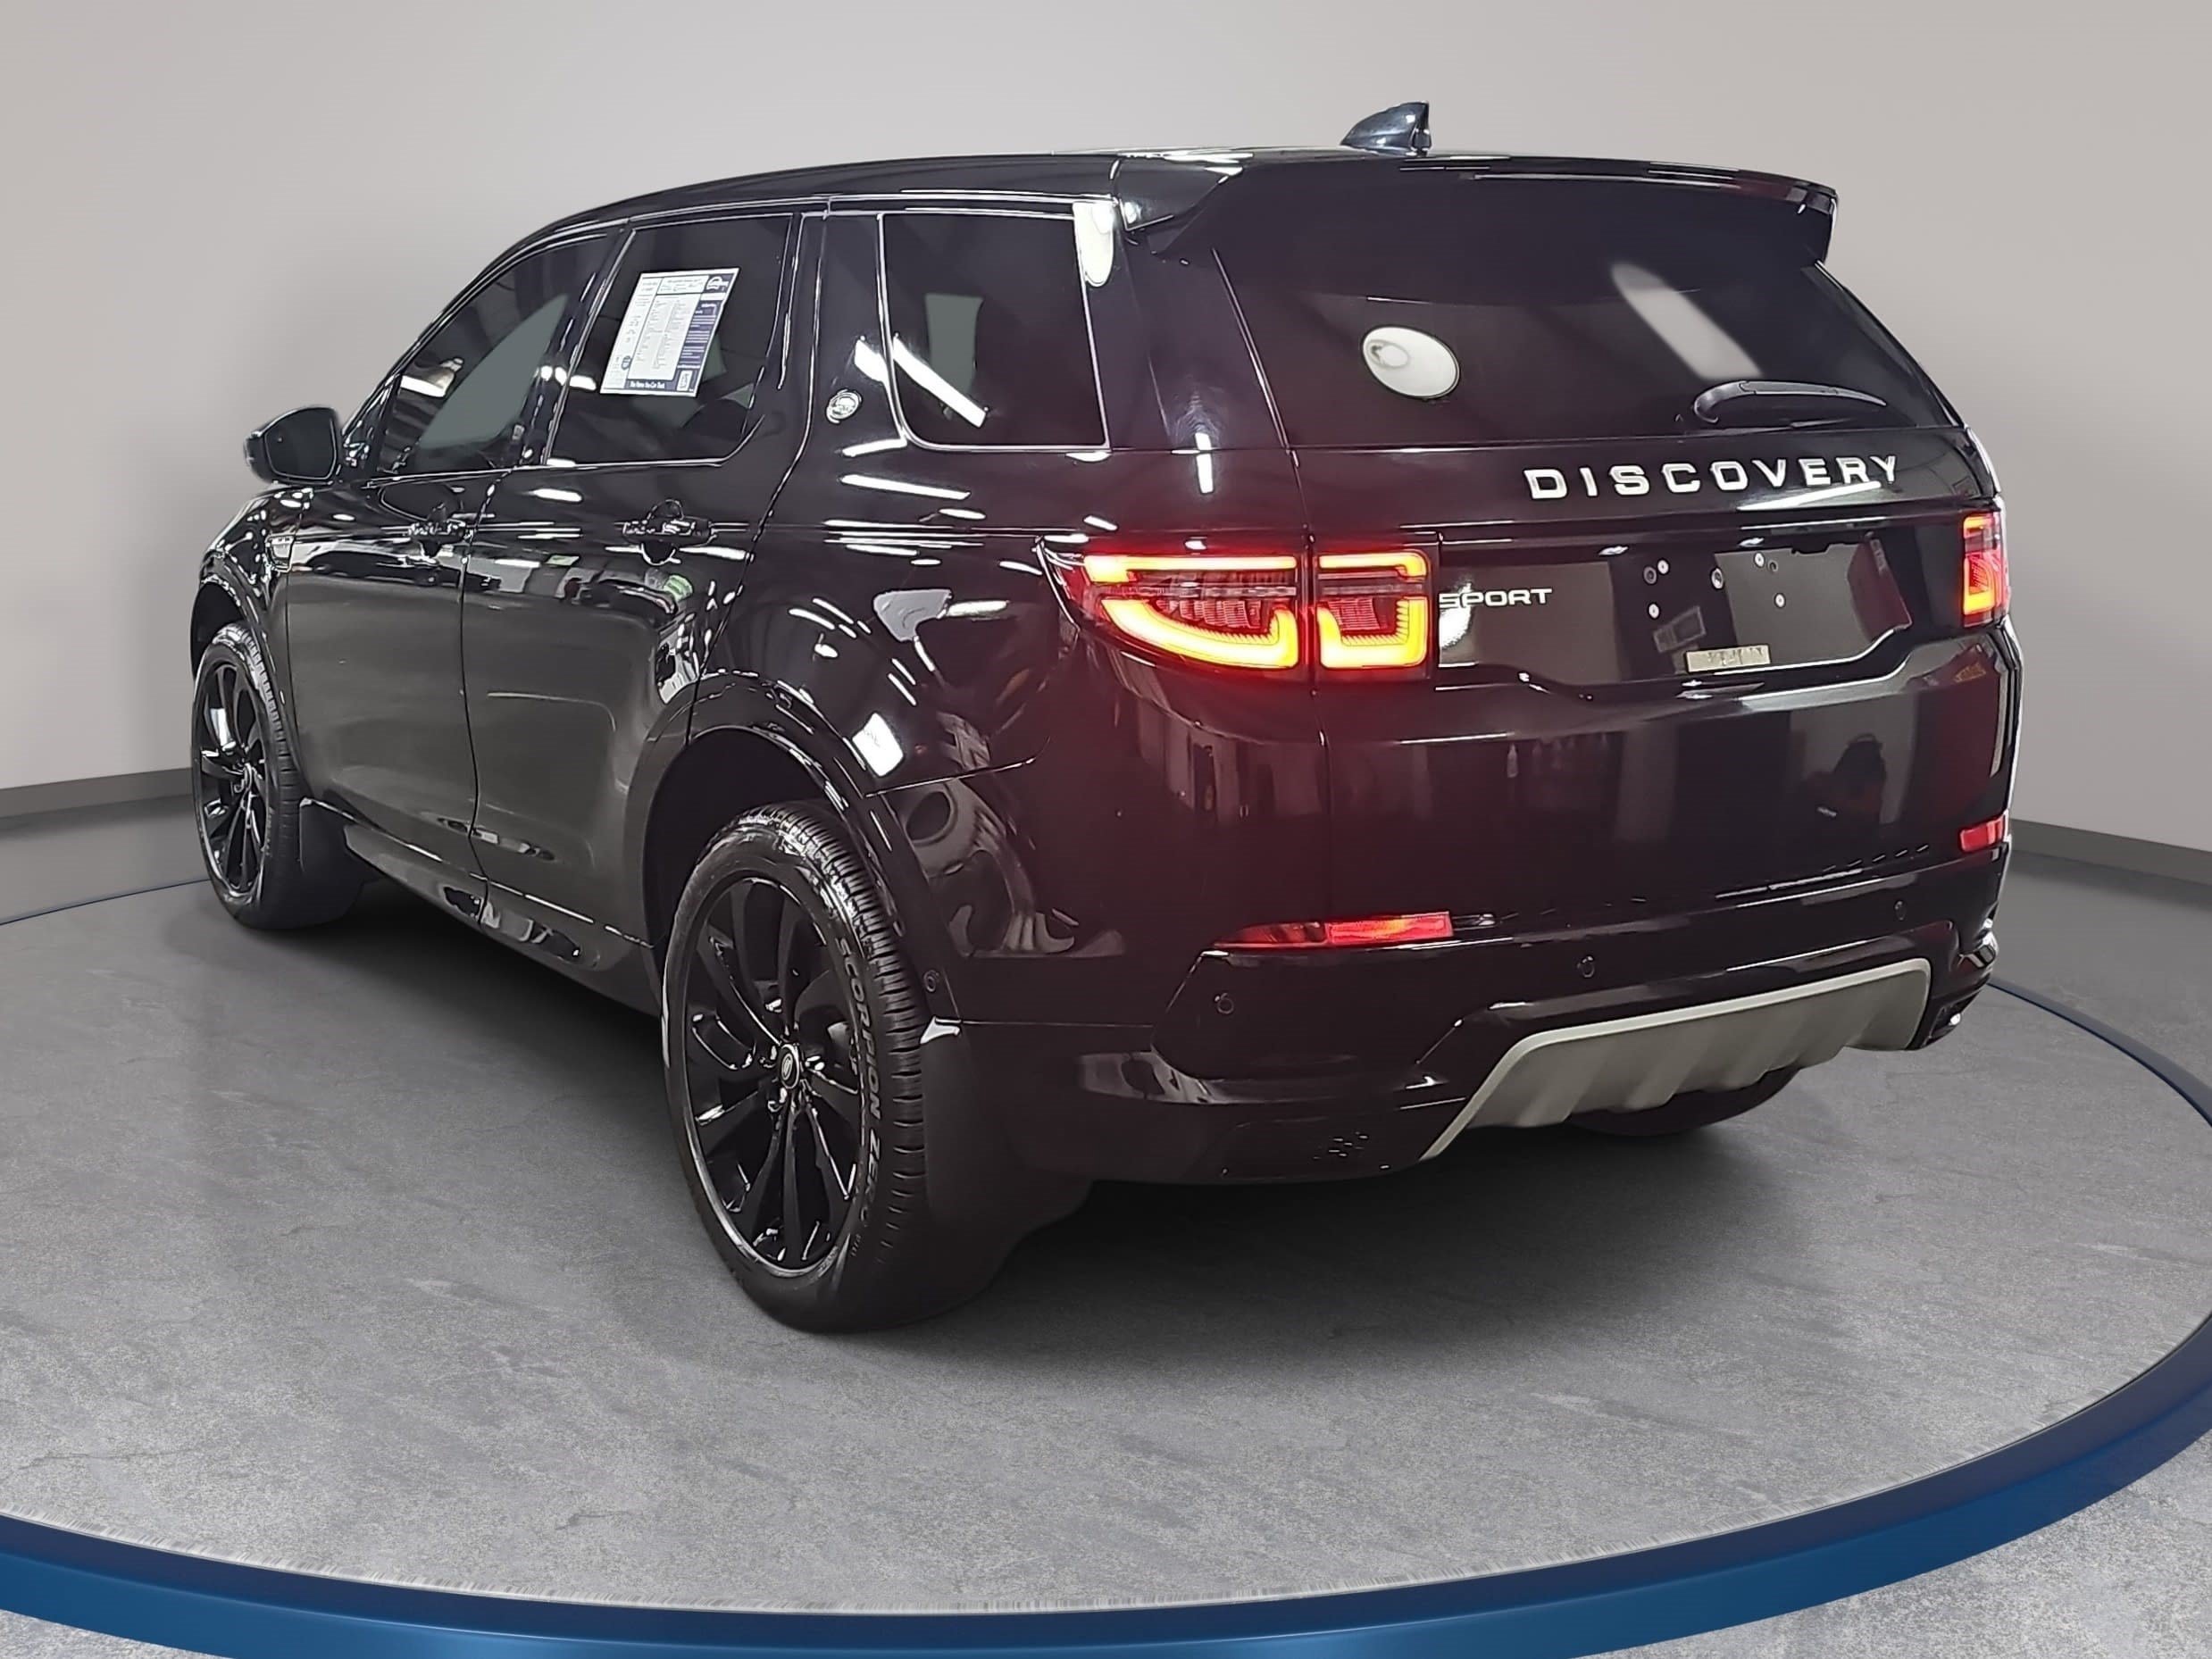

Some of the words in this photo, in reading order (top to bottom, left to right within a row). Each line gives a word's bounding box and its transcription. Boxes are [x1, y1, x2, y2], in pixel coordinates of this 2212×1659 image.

[1523, 455, 1898, 500] DISCOVERY
[1440, 588, 1552, 609] SPORT
[836, 937, 881, 1121] SCORPION
